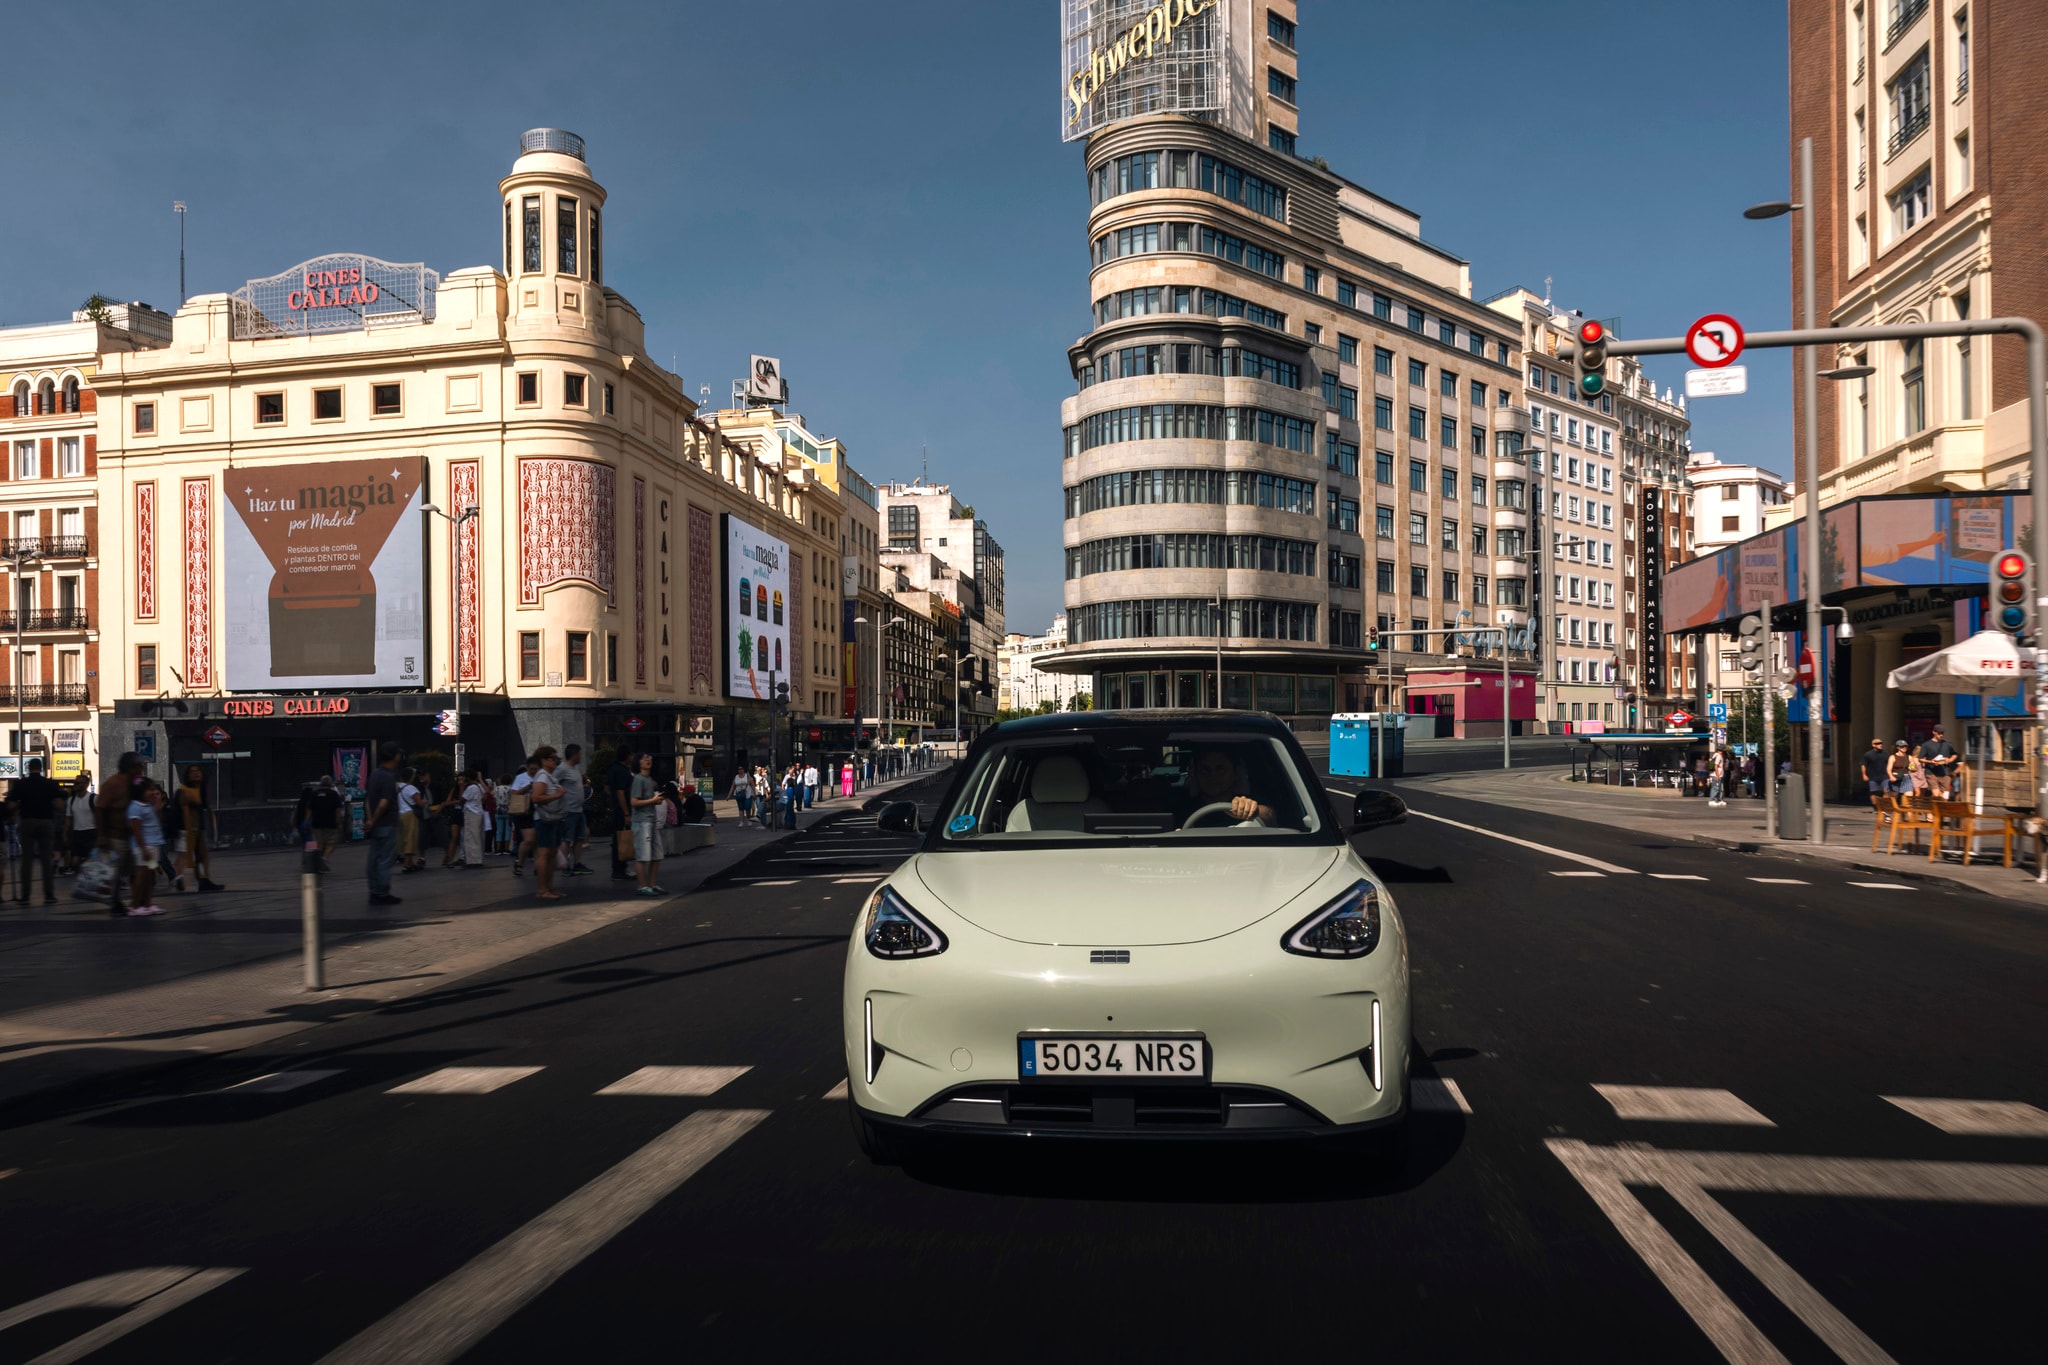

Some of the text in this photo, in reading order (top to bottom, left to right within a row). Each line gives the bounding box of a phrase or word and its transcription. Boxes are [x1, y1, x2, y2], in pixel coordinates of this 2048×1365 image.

[1068, 0, 1218, 125] Schwepp
[305, 267, 361, 288] CINES
[287, 283, 379, 310] CALLAO
[250, 475, 396, 516] Haz tu magia
[288, 510, 356, 537] por Madrid
[284, 552, 361, 565] y plantas DENTRO del
[287, 546, 319, 554] Residuos
[331, 543, 358, 552] comida
[755, 545, 779, 573] magia
[289, 563, 357, 574] contenedor marrón
[660, 500, 669, 677] CALLAO
[1646, 492, 1656, 685] ROOM MATE MACARENA
[1454, 609, 1537, 656] Capitol
[1980, 660, 2014, 669] FIVE
[223, 697, 350, 715] CINES CALLAO
[1713, 706, 1723, 717] P
[56, 740, 79, 748] CHANGE
[57, 732, 80, 740] CAMBIO
[1025, 1043, 1196, 1072] E 5034 NRS
